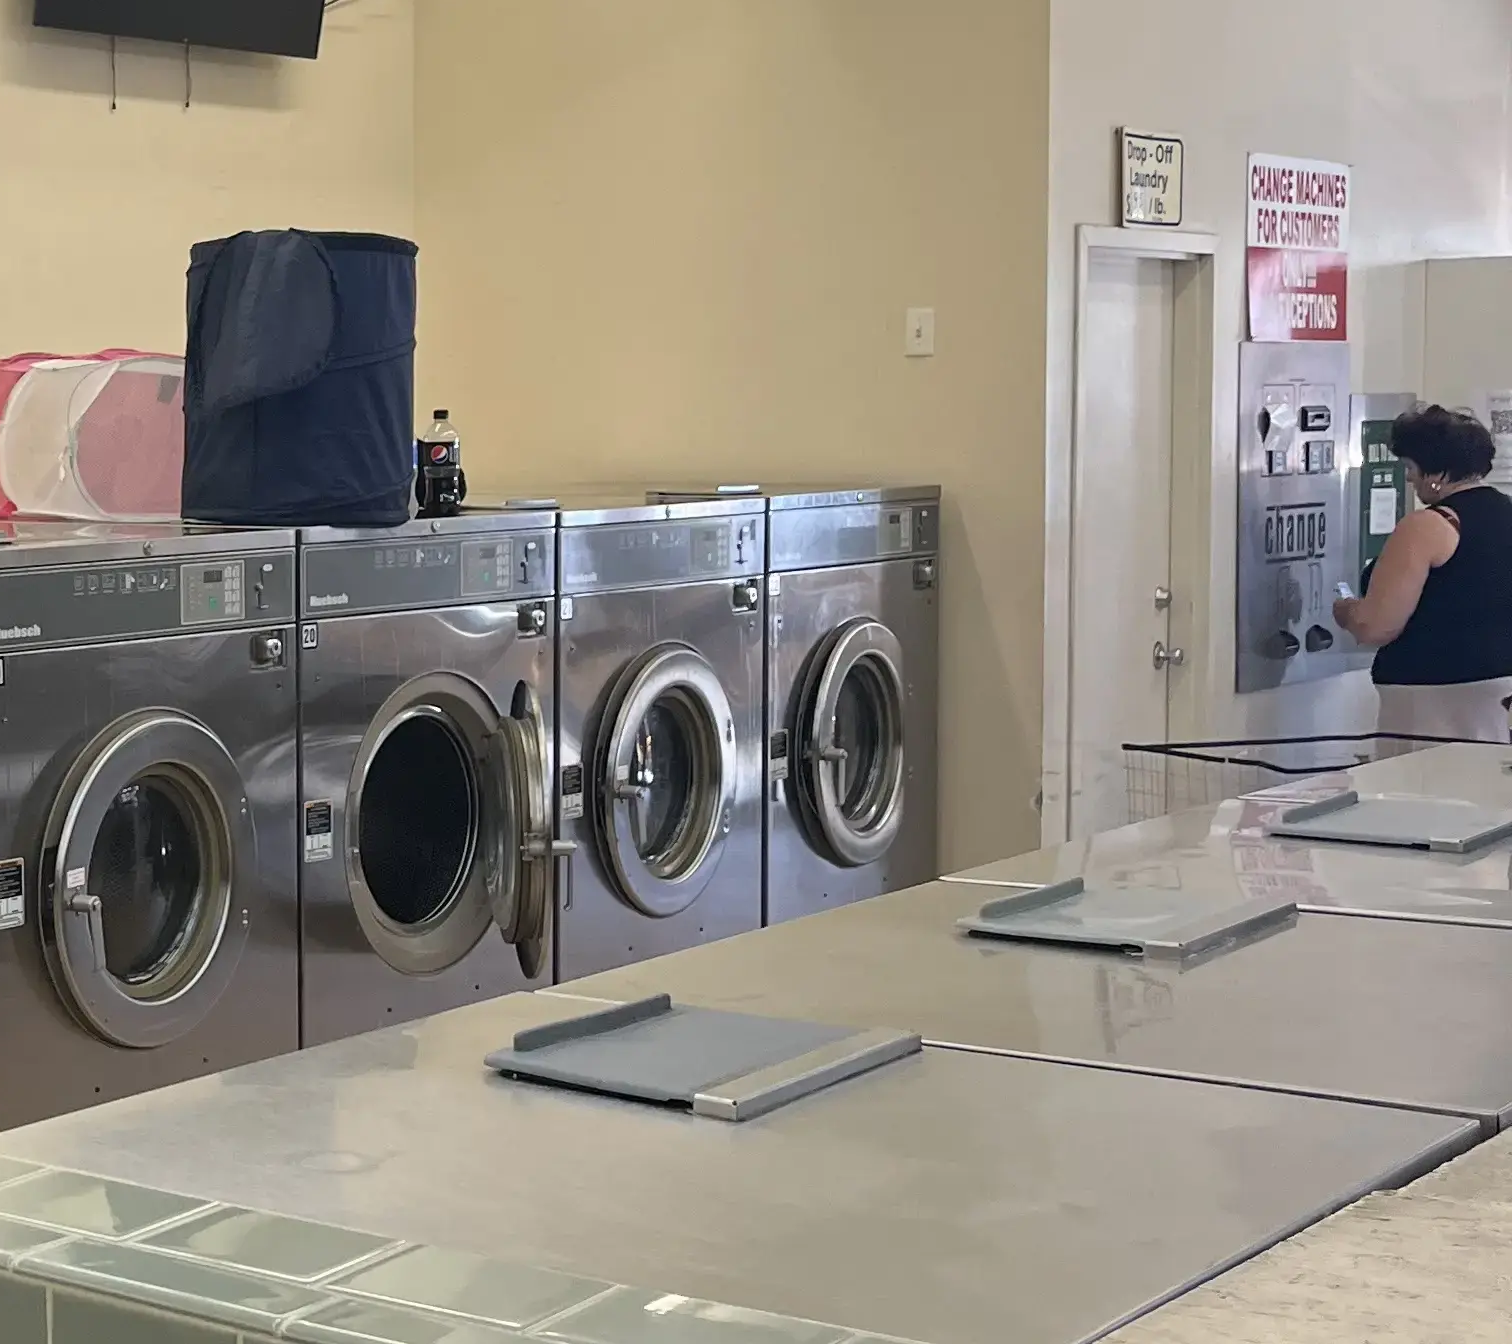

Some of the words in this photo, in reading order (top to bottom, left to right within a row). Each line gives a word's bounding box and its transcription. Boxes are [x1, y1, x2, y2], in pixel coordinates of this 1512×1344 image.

[1127, 140, 1147, 167] Drop
[1156, 144, 1174, 164] Off
[1129, 167, 1169, 194] Laundry
[1251, 164, 1294, 204] CHANGE
[1295, 170, 1346, 209] MACHINES
[1257, 208, 1278, 244] FOR
[1280, 210, 1339, 248] CUSTOMERS
[1265, 506, 1326, 558] change
[304, 628, 316, 644] 20
